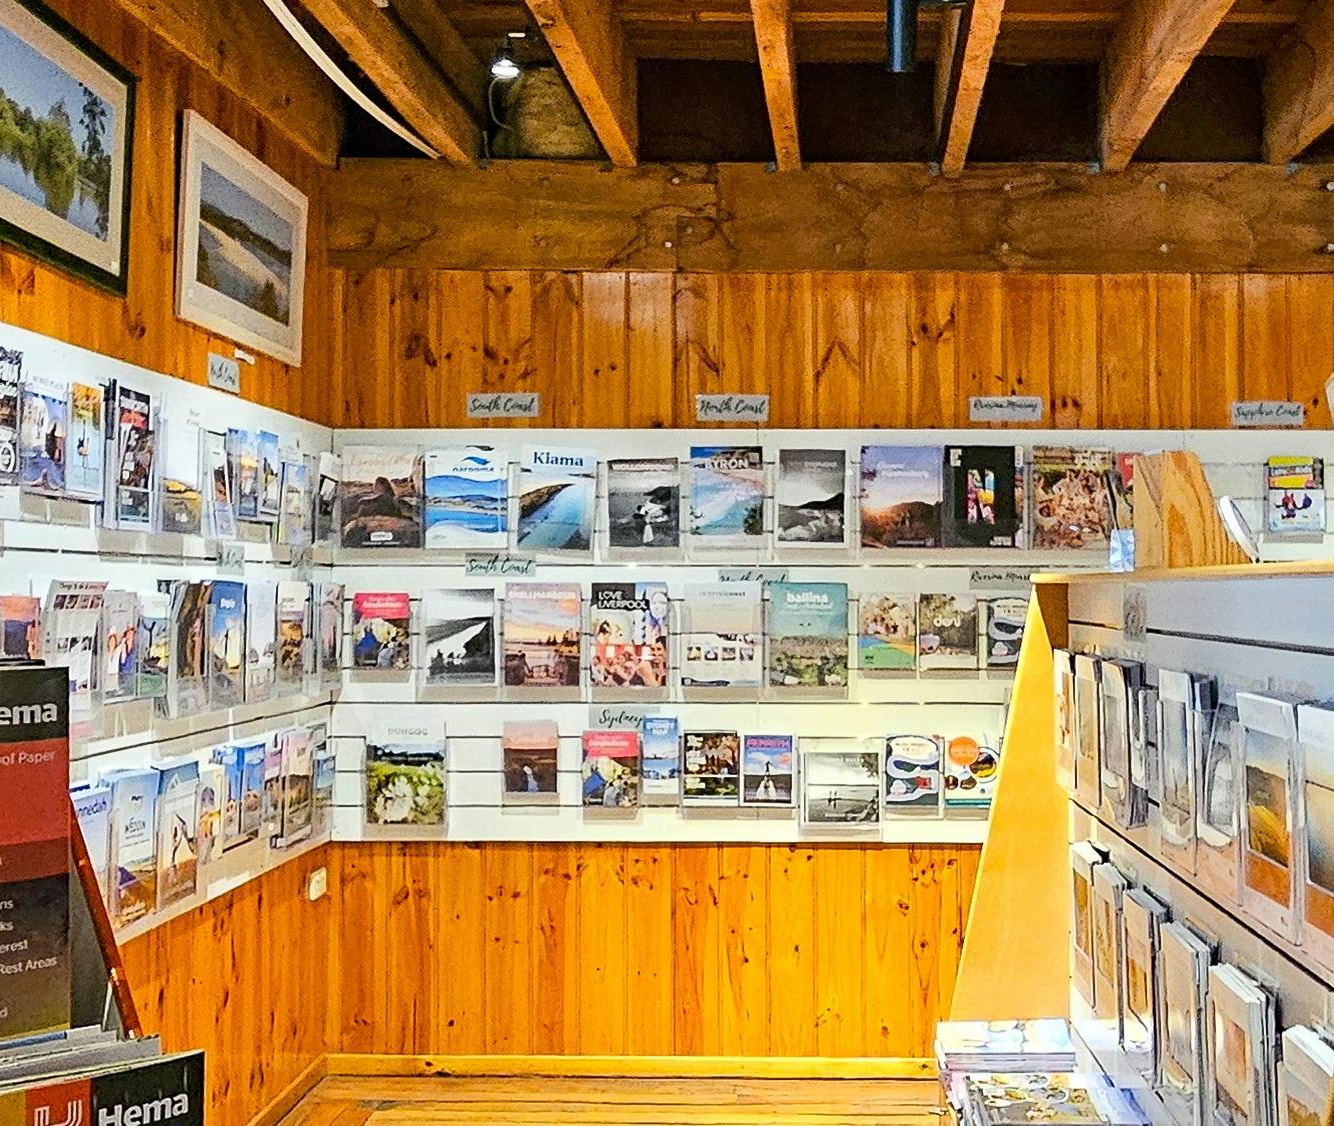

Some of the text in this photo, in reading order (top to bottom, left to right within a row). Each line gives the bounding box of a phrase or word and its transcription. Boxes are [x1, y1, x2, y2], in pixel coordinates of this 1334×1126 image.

[534, 450, 584, 467] Kiama
[705, 458, 749, 470] BYRON
[18, 749, 56, 768] Paper
[25, 956, 58, 971] Areas
